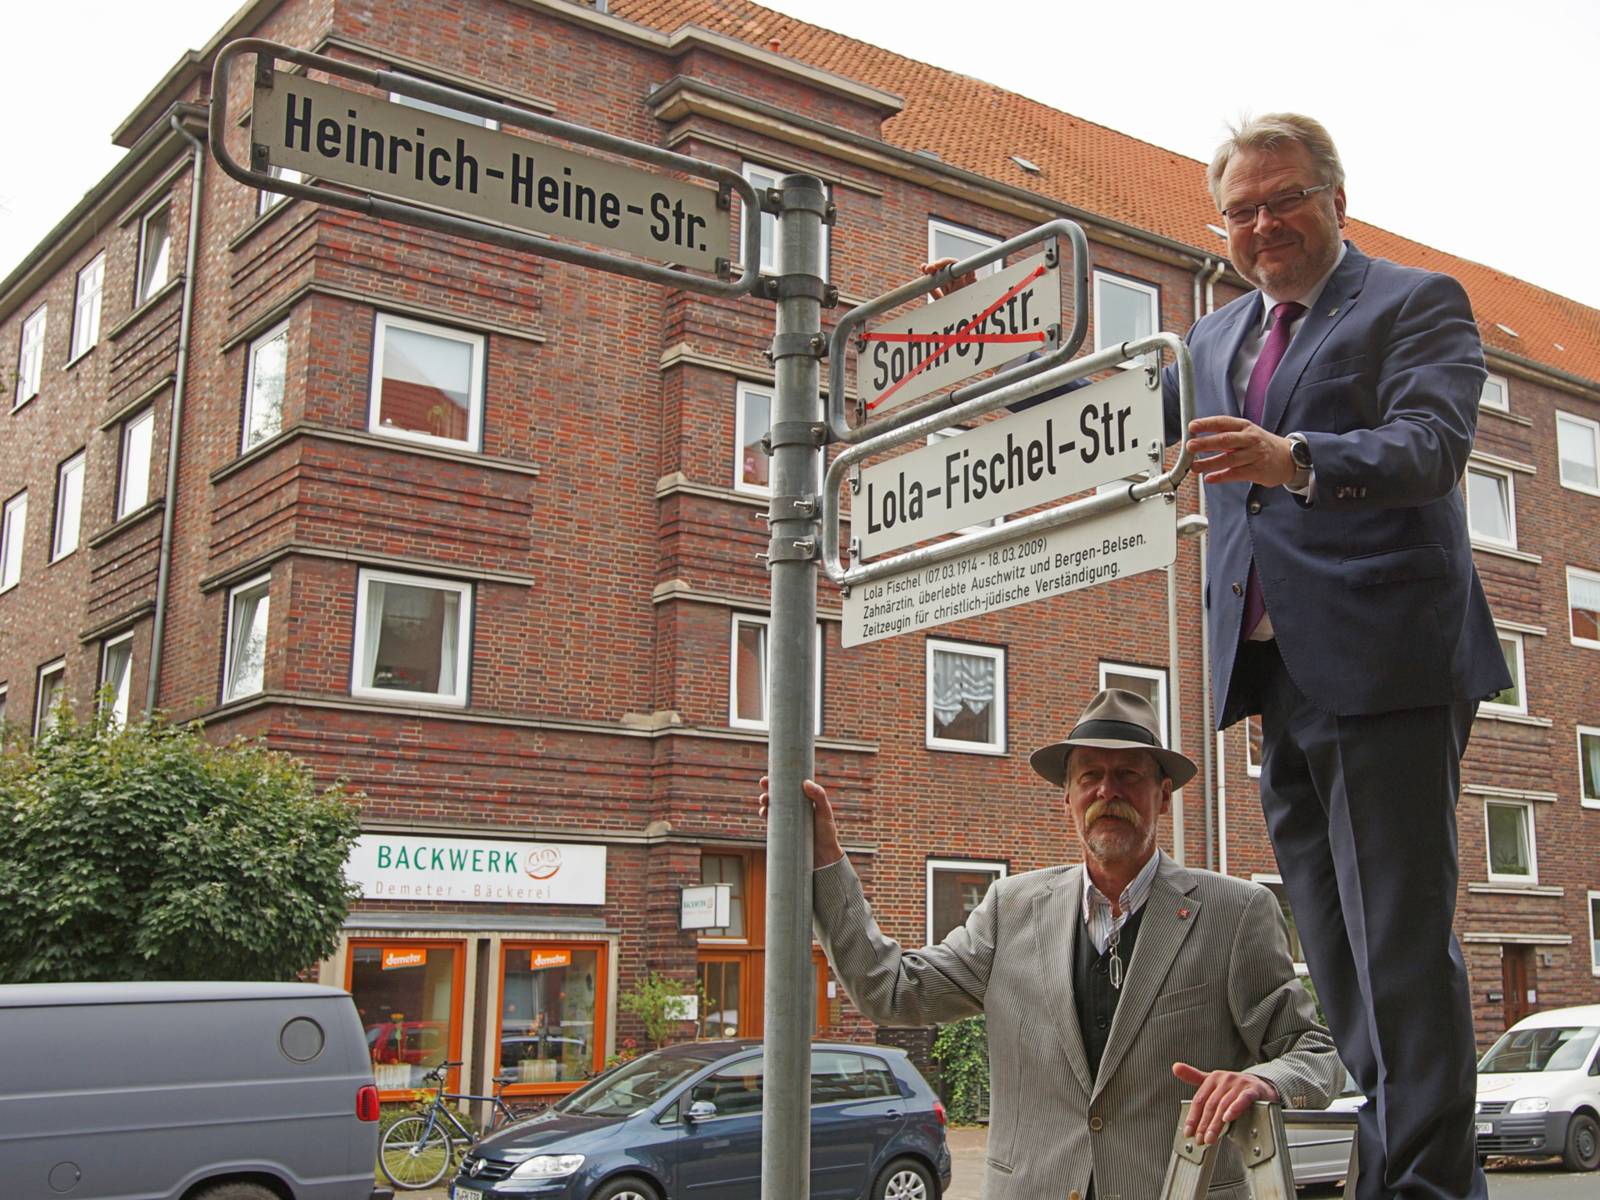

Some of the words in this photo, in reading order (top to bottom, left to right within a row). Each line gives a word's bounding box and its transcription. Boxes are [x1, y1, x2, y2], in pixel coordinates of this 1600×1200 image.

[284, 93, 707, 252] Heinrich-Heine-Str.
[867, 402, 1138, 534] Lola-Fischel-Str.
[862, 614, 911, 638] Zeitzeugin
[915, 610, 930, 625] für
[934, 584, 1030, 620] christlich-jüdische
[1035, 561, 1121, 594] Verständigung.
[863, 586, 883, 601] Lola
[886, 573, 921, 595] Fischel
[988, 537, 1047, 566] 18.03.2009)
[863, 599, 914, 619] Zahnärztin,
[918, 582, 966, 605] überlebte
[971, 563, 1026, 591] Auschwitz
[1030, 556, 1050, 575] und
[1054, 533, 1147, 569] Bergen-Belsen.
[375, 881, 453, 897] Demeter
[473, 884, 553, 899] Bäckerei
[377, 845, 518, 873] BACKWERK
[386, 952, 421, 965] demeter
[534, 954, 567, 966] demeter
